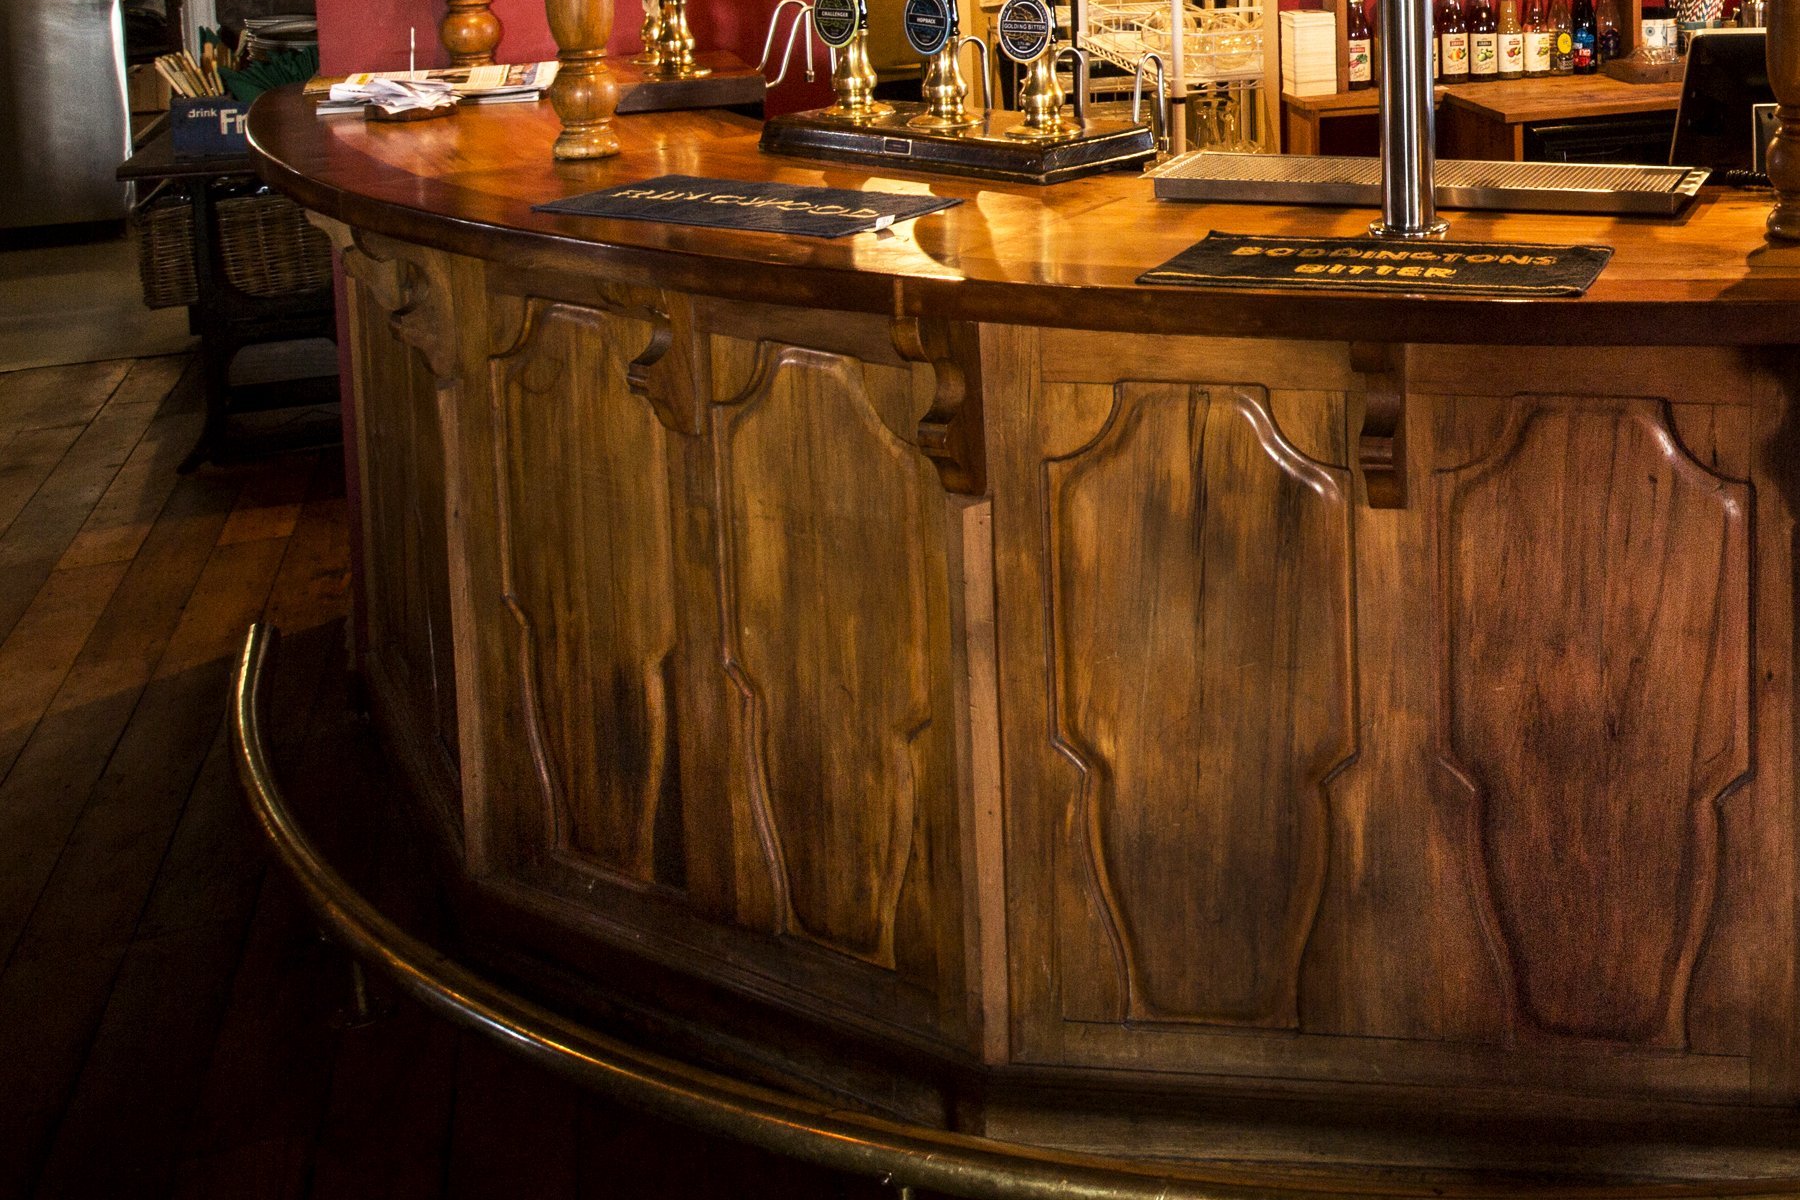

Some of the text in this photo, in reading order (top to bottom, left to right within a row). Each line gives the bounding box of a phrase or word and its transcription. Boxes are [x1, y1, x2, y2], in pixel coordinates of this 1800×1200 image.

[821, 10, 849, 18] CHALLENGER
[916, 16, 937, 25] HOPBACK
[187, 107, 219, 119] drink
[1229, 245, 1559, 267] BODDINGTONS
[1294, 263, 1459, 281] BITTER
